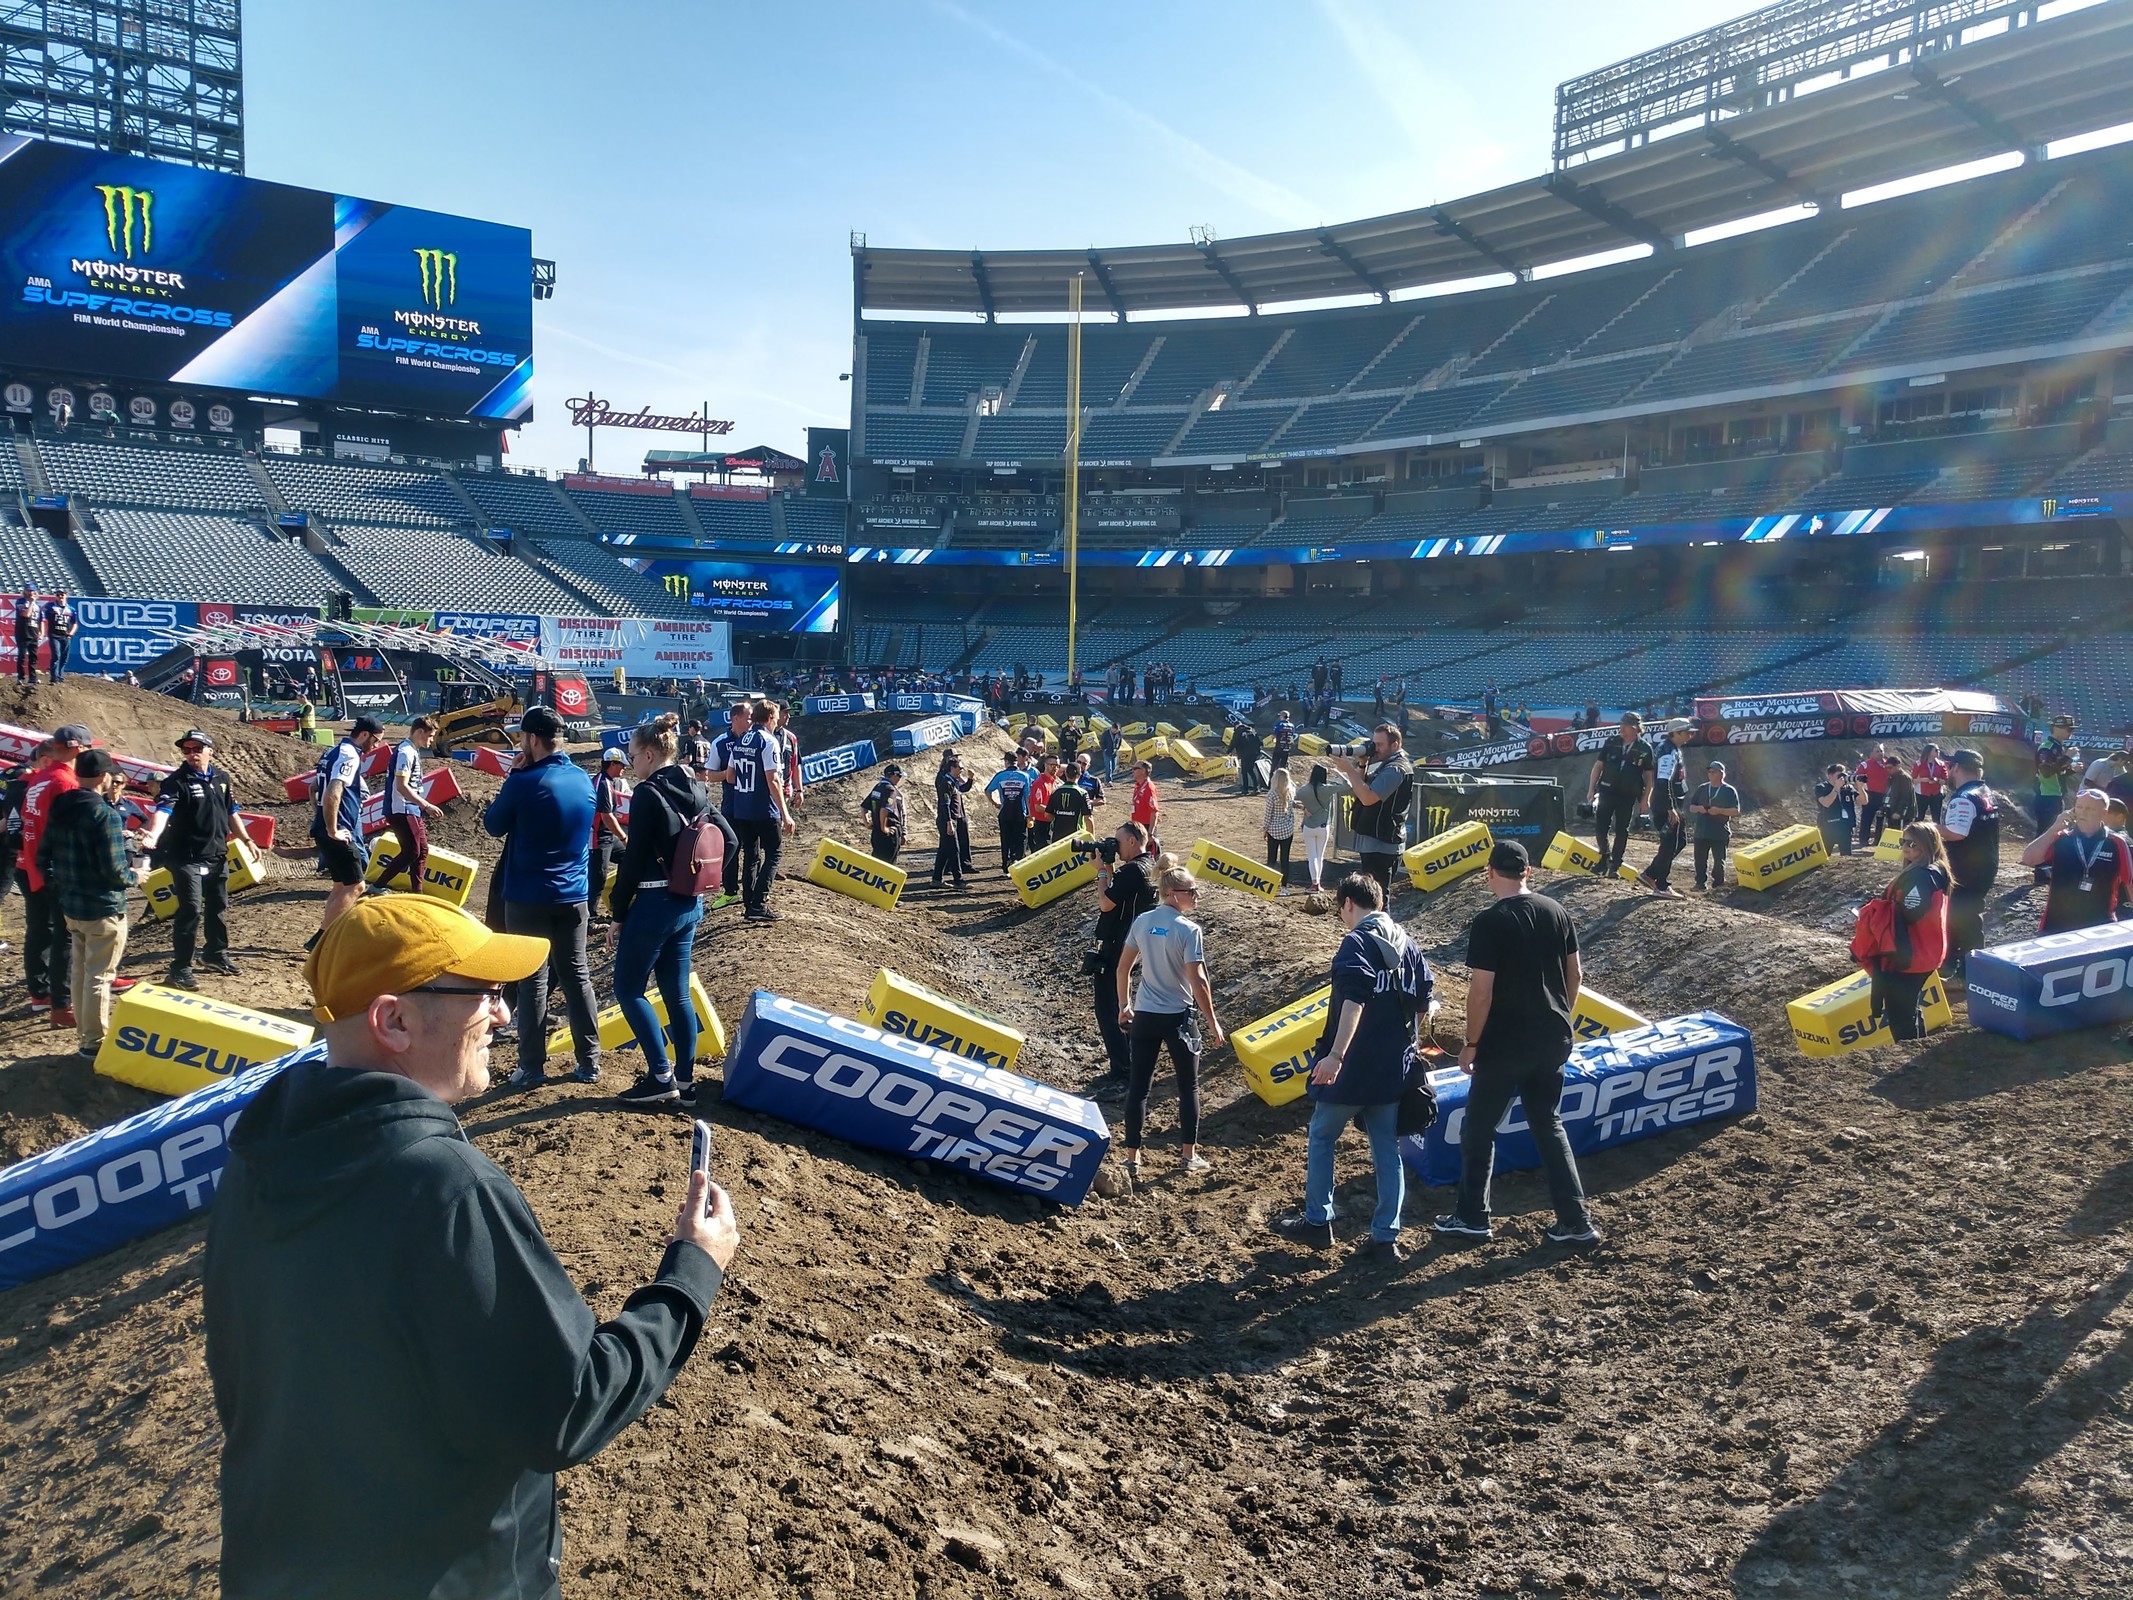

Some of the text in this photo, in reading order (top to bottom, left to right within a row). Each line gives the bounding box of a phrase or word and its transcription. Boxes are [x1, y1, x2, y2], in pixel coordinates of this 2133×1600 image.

[71, 258, 186, 289] MONSTER
[27, 276, 52, 288] AMA
[90, 279, 172, 297] ENERGY
[22, 286, 233, 328] SUPERCROSS
[73, 313, 186, 336] FIM World Championship
[394, 310, 481, 335] MONSTER
[361, 325, 380, 336] AMA
[408, 328, 469, 342] ENERGY
[356, 334, 517, 367] SUPERCROSS
[395, 356, 481, 375] FIM World Championship
[12, 388, 25, 402] 11
[133, 401, 153, 415] 30
[172, 406, 192, 418] 42
[212, 408, 230, 421] 50
[565, 397, 736, 436] Budweiser
[336, 434, 370, 443] CLASSIC
[765, 458, 799, 470] PATIO
[816, 545, 842, 554] 10:49
[712, 579, 768, 591] MONSTER
[691, 597, 793, 610] SUPERCROSS
[77, 602, 176, 630] WPS
[438, 616, 538, 631] COOPER
[558, 618, 622, 630] DISCOUNT
[653, 622, 712, 633] AMERICA'S
[670, 633, 696, 641] TIRE
[80, 637, 178, 664] WPS
[559, 649, 623, 660] DISCOUNT
[654, 651, 714, 661] AMERICA'S
[341, 656, 383, 670] AMA
[204, 692, 241, 700] TOYOTA
[329, 673, 345, 717] TOYOTA
[345, 694, 399, 705] FLY
[1766, 697, 1816, 706] MOUNTAIN
[817, 697, 850, 713] WPS
[896, 696, 922, 710] WPS
[1744, 719, 1824, 731] ROCKY MOUNTAIN
[1882, 714, 1906, 722] ROCKY
[1591, 726, 1620, 739] ROCKY
[2091, 735, 2125, 743] MOUNTAIN
[1457, 741, 1527, 762] ROCKY MOUNTAIN
[804, 751, 857, 781] WPS
[1468, 807, 1520, 818] MONSTER
[1411, 823, 1475, 854] SUZUKI
[1744, 826, 1806, 856] SUZUKI
[1880, 841, 1901, 850] SUZUK
[1424, 838, 1490, 875] SUZUKI
[1760, 841, 1822, 878] SUZUKI
[822, 854, 898, 896] SUZUKI
[1025, 850, 1090, 892] SUZUK
[1206, 857, 1275, 896] SUZUKI
[1968, 982, 2019, 1006] COOPER
[141, 987, 298, 1036] SUZUKI
[1991, 998, 2018, 1012] TIRES
[882, 1011, 1009, 1070] SUZUKI
[1795, 1028, 1831, 1046] SUZUKI
[772, 998, 1087, 1110] COOPER
[758, 1035, 1090, 1169] COOPER
[1594, 1082, 1740, 1142] TIRES
[909, 1124, 1068, 1192] TIRES
